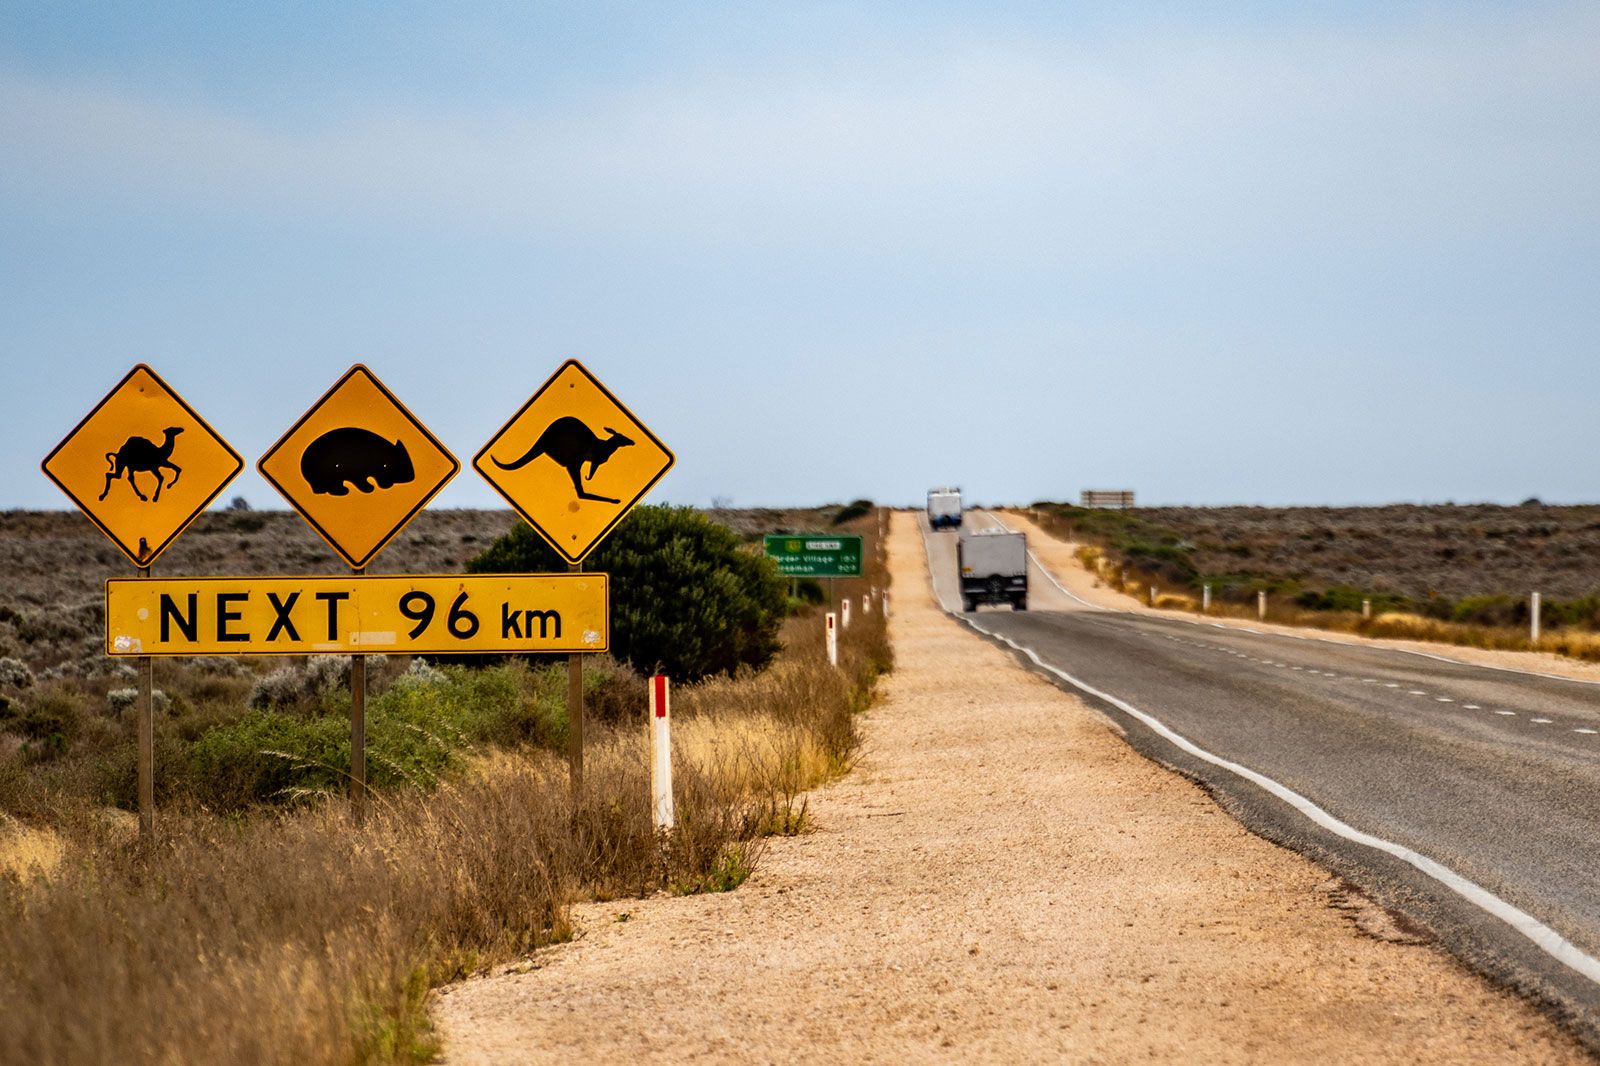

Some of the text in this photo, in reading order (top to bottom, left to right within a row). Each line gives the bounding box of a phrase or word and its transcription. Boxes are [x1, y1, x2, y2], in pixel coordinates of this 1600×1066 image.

[160, 590, 562, 643] NEXT 96 km
